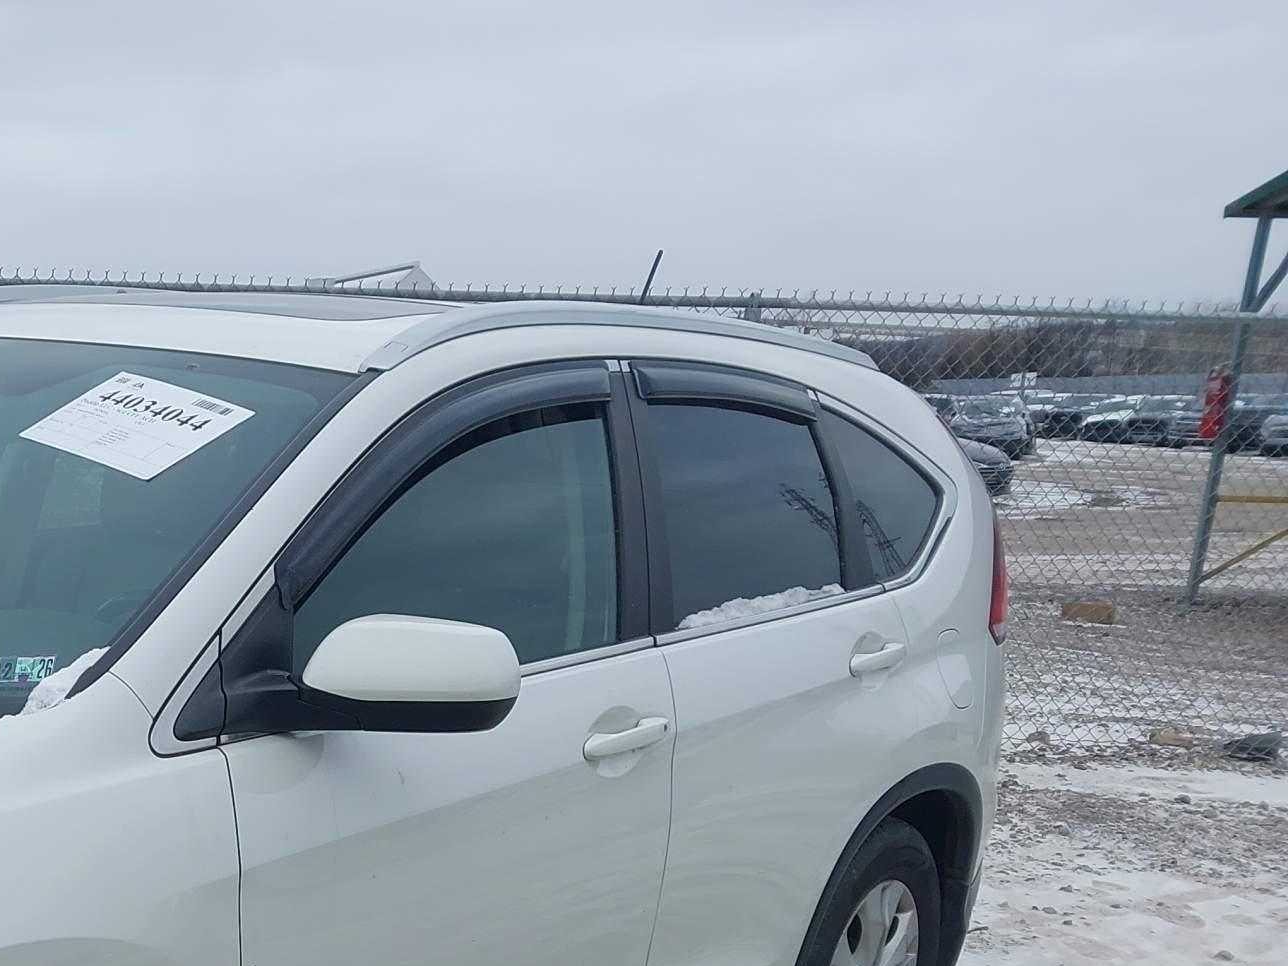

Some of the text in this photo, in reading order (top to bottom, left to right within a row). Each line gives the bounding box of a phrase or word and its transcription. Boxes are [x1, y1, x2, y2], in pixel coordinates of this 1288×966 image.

[99, 390, 213, 431] 44034044
[2, 658, 54, 679] 2 26
